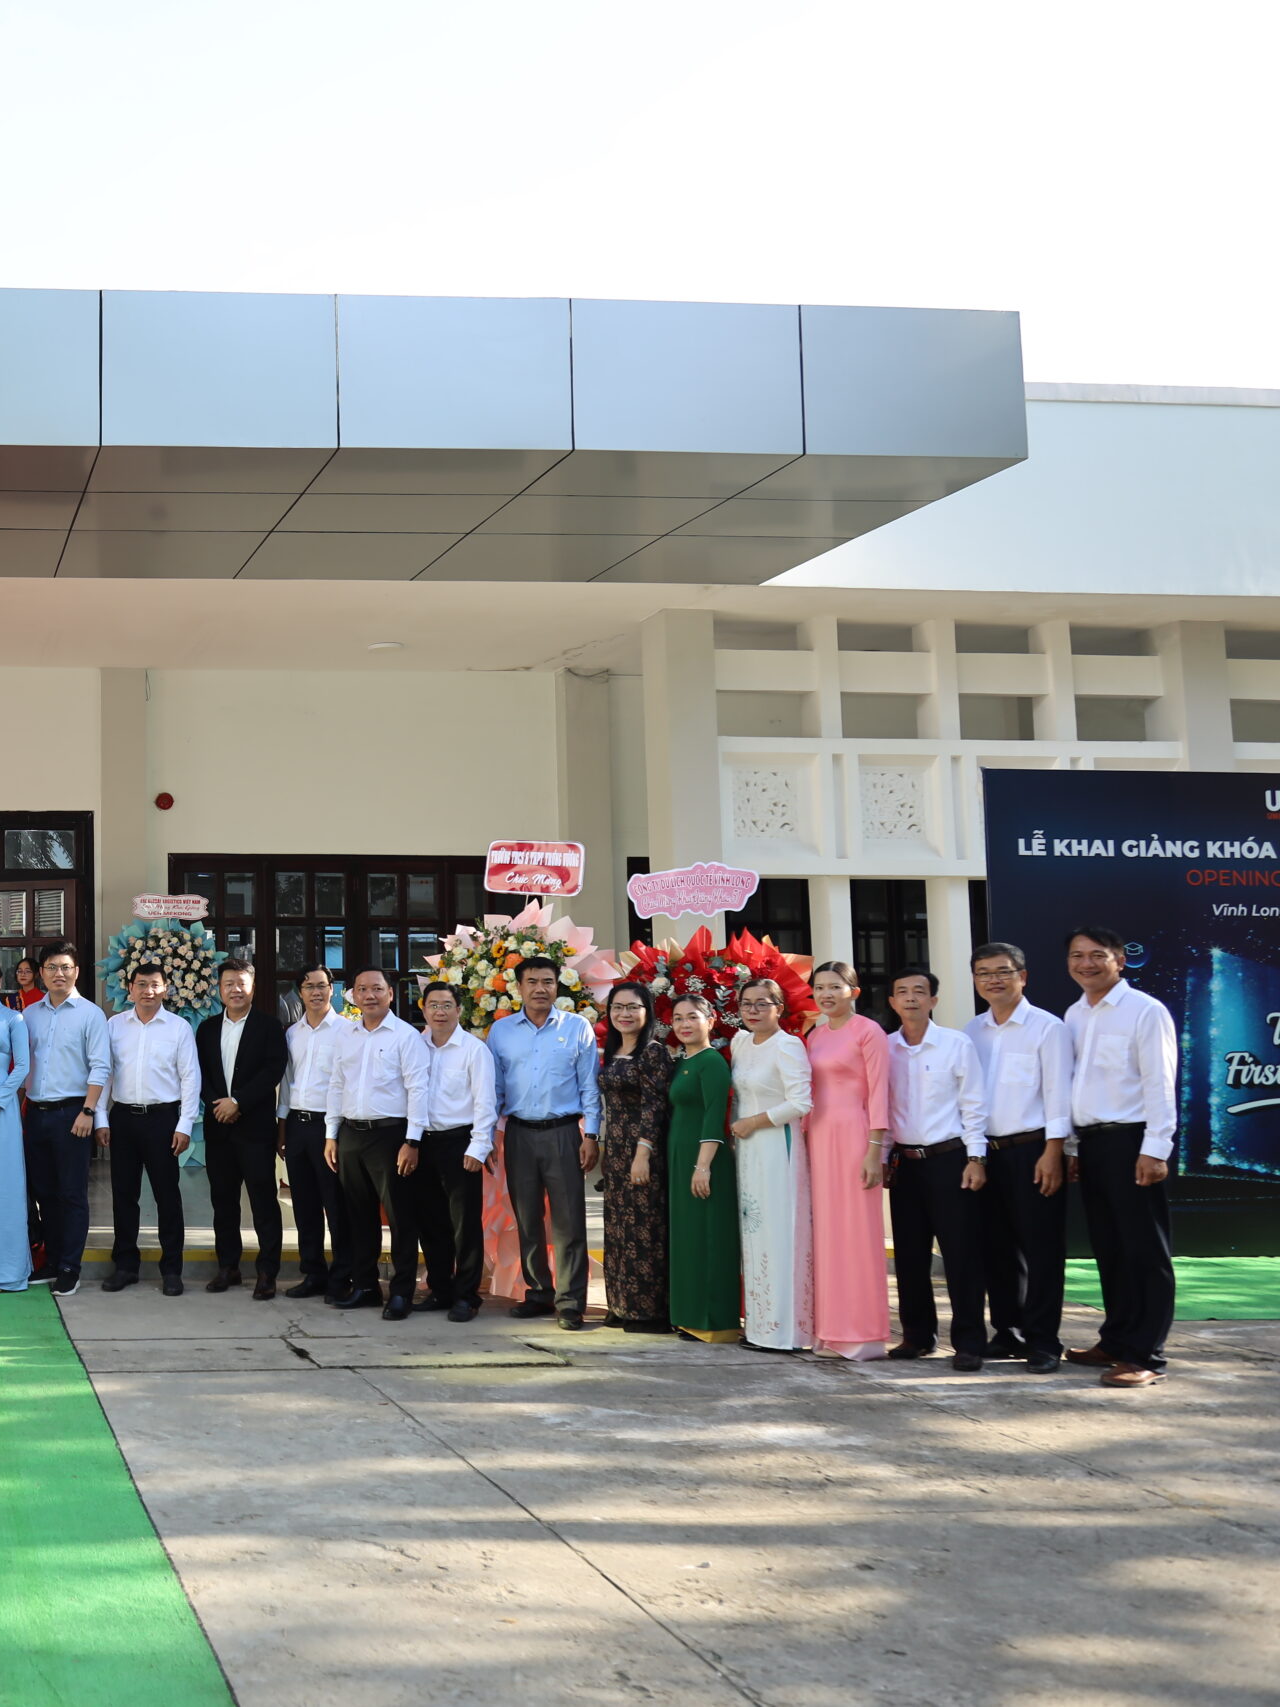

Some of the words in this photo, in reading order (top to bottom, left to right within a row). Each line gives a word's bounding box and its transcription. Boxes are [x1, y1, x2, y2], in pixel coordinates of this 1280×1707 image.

[1018, 830, 1047, 856] LỄ
[1053, 839, 1115, 857] KHAI
[1121, 833, 1200, 858] GIẢNG
[1206, 836, 1278, 859] KHÓA
[1212, 904, 1247, 916] Vĩnh
[1252, 904, 1280, 917] Lon
